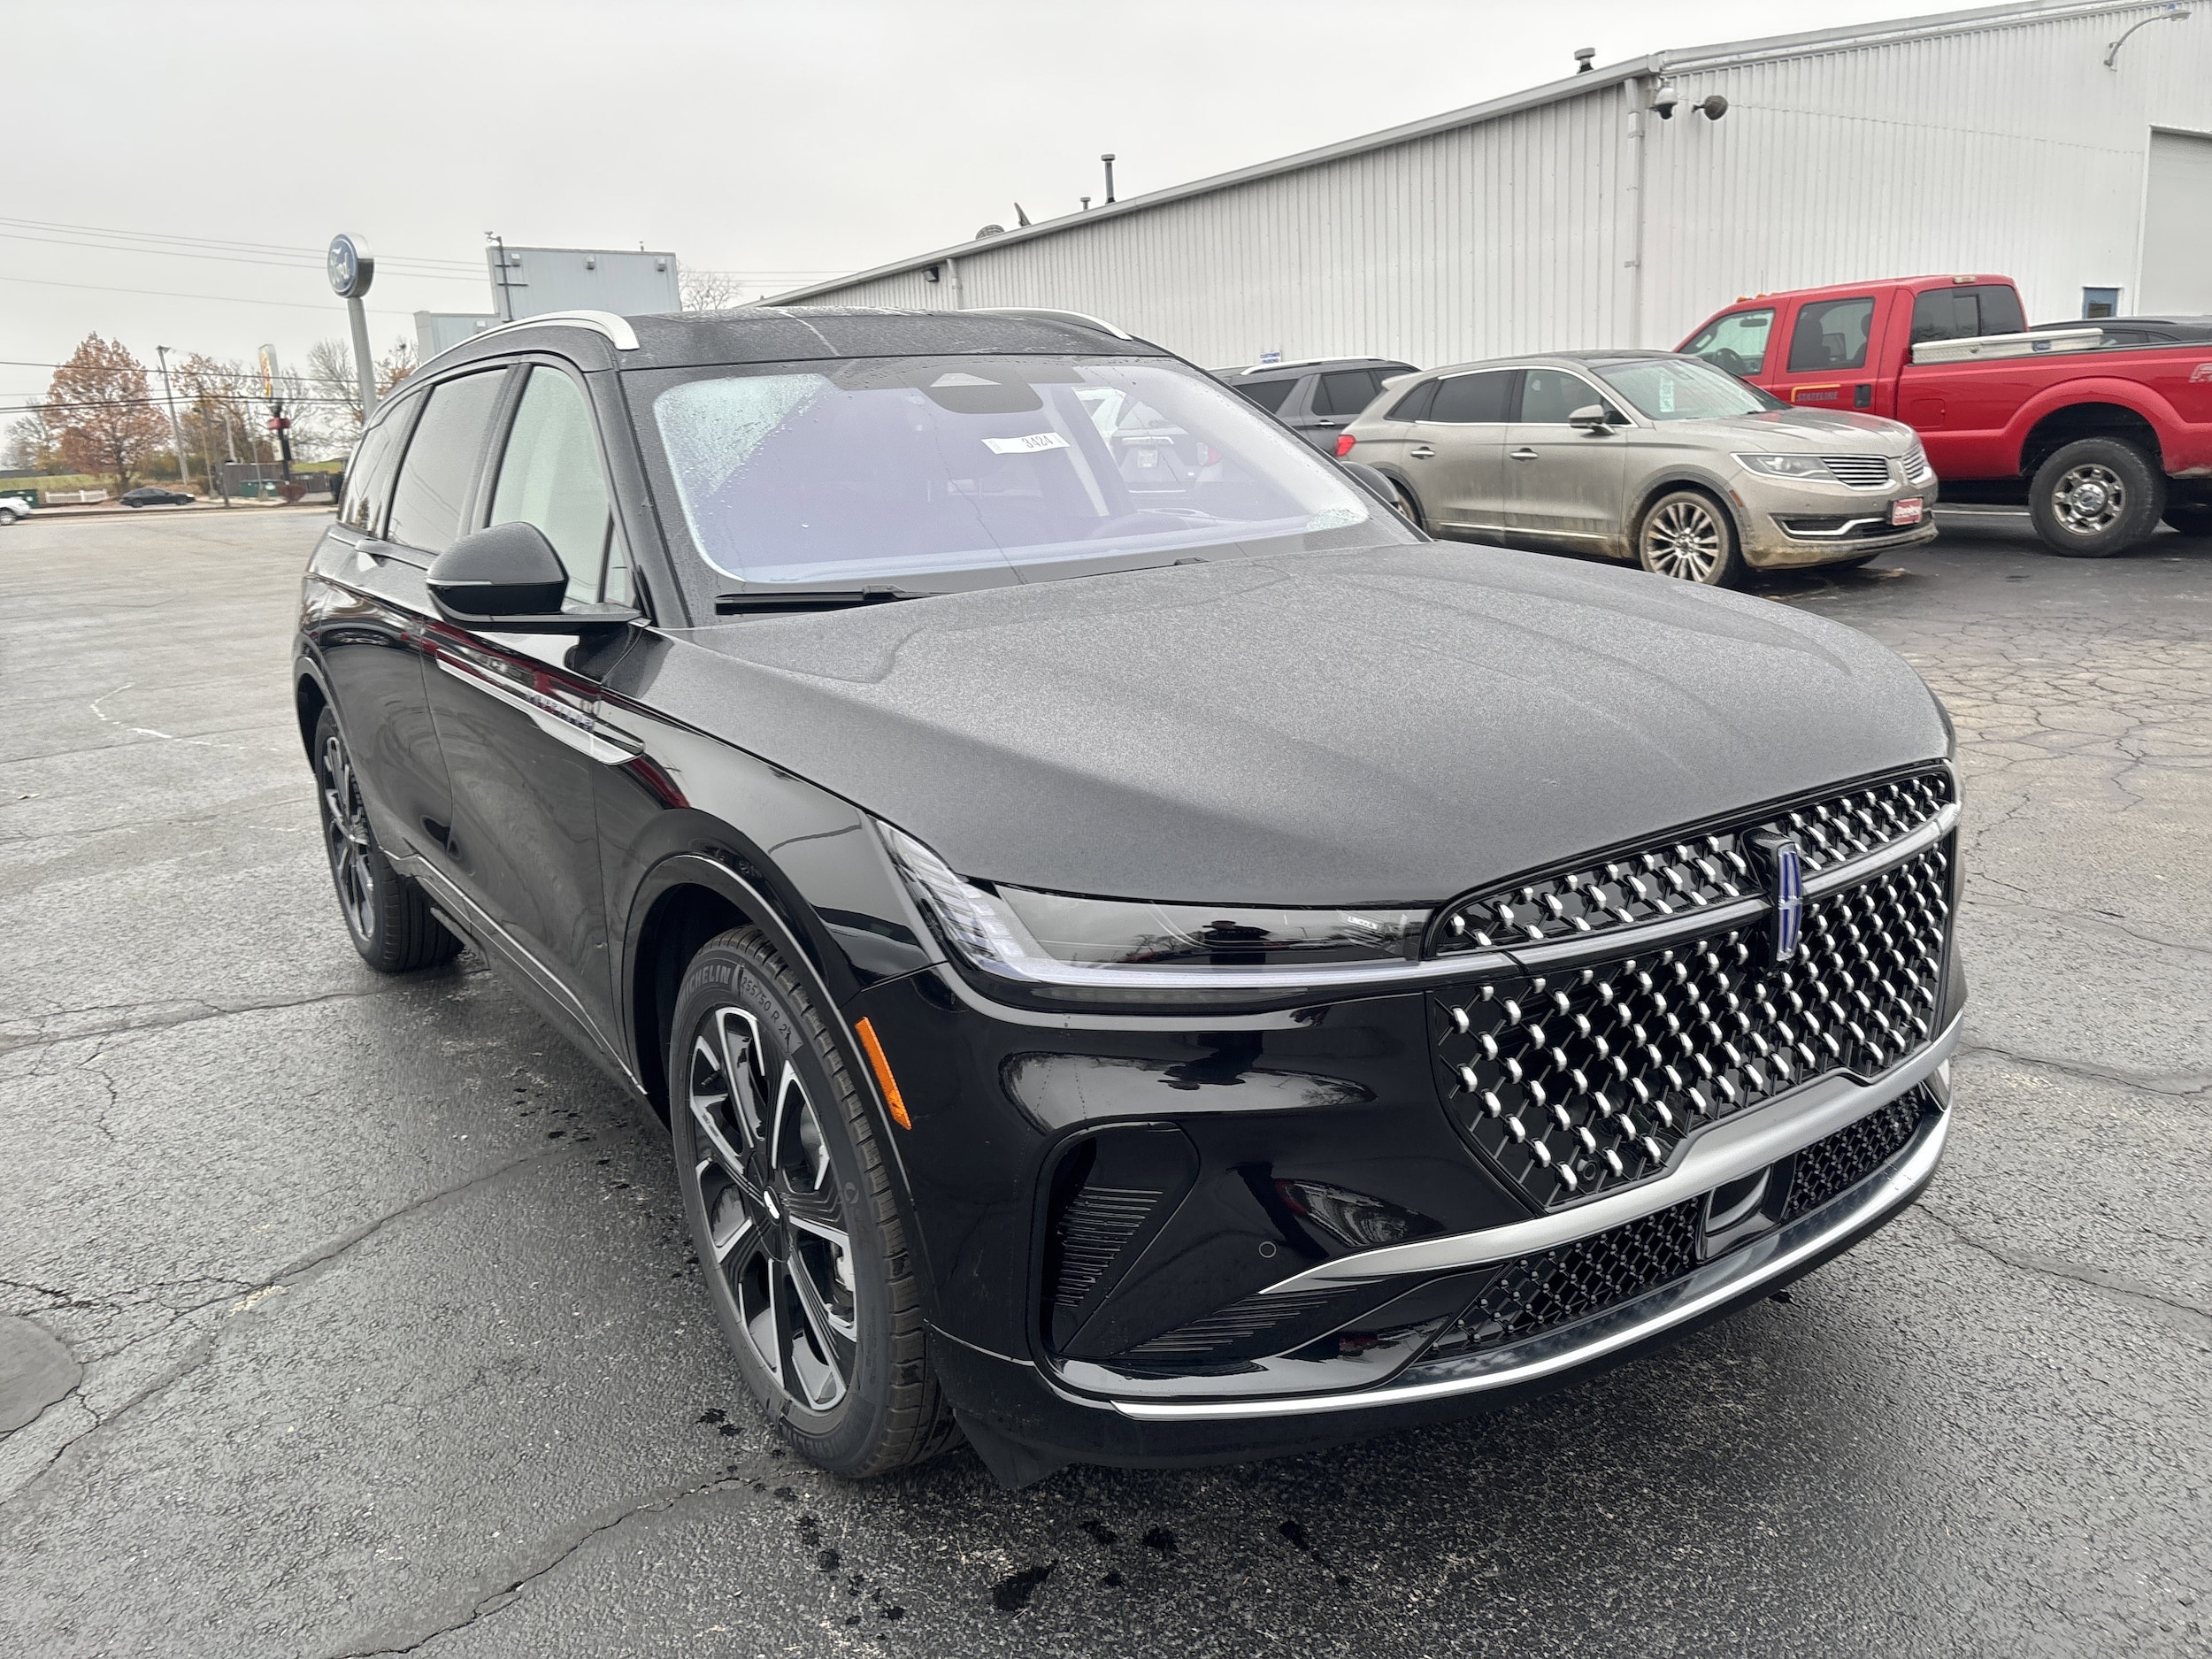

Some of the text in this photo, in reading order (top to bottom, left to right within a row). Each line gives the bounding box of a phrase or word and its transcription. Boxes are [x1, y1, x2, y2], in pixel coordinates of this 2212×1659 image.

[330, 246, 350, 285] Ford
[1796, 391, 1839, 402] STATELINE
[1021, 434, 1054, 449] 3424
[741, 977, 772, 1011] 255/50
[772, 1010, 780, 1024] R
